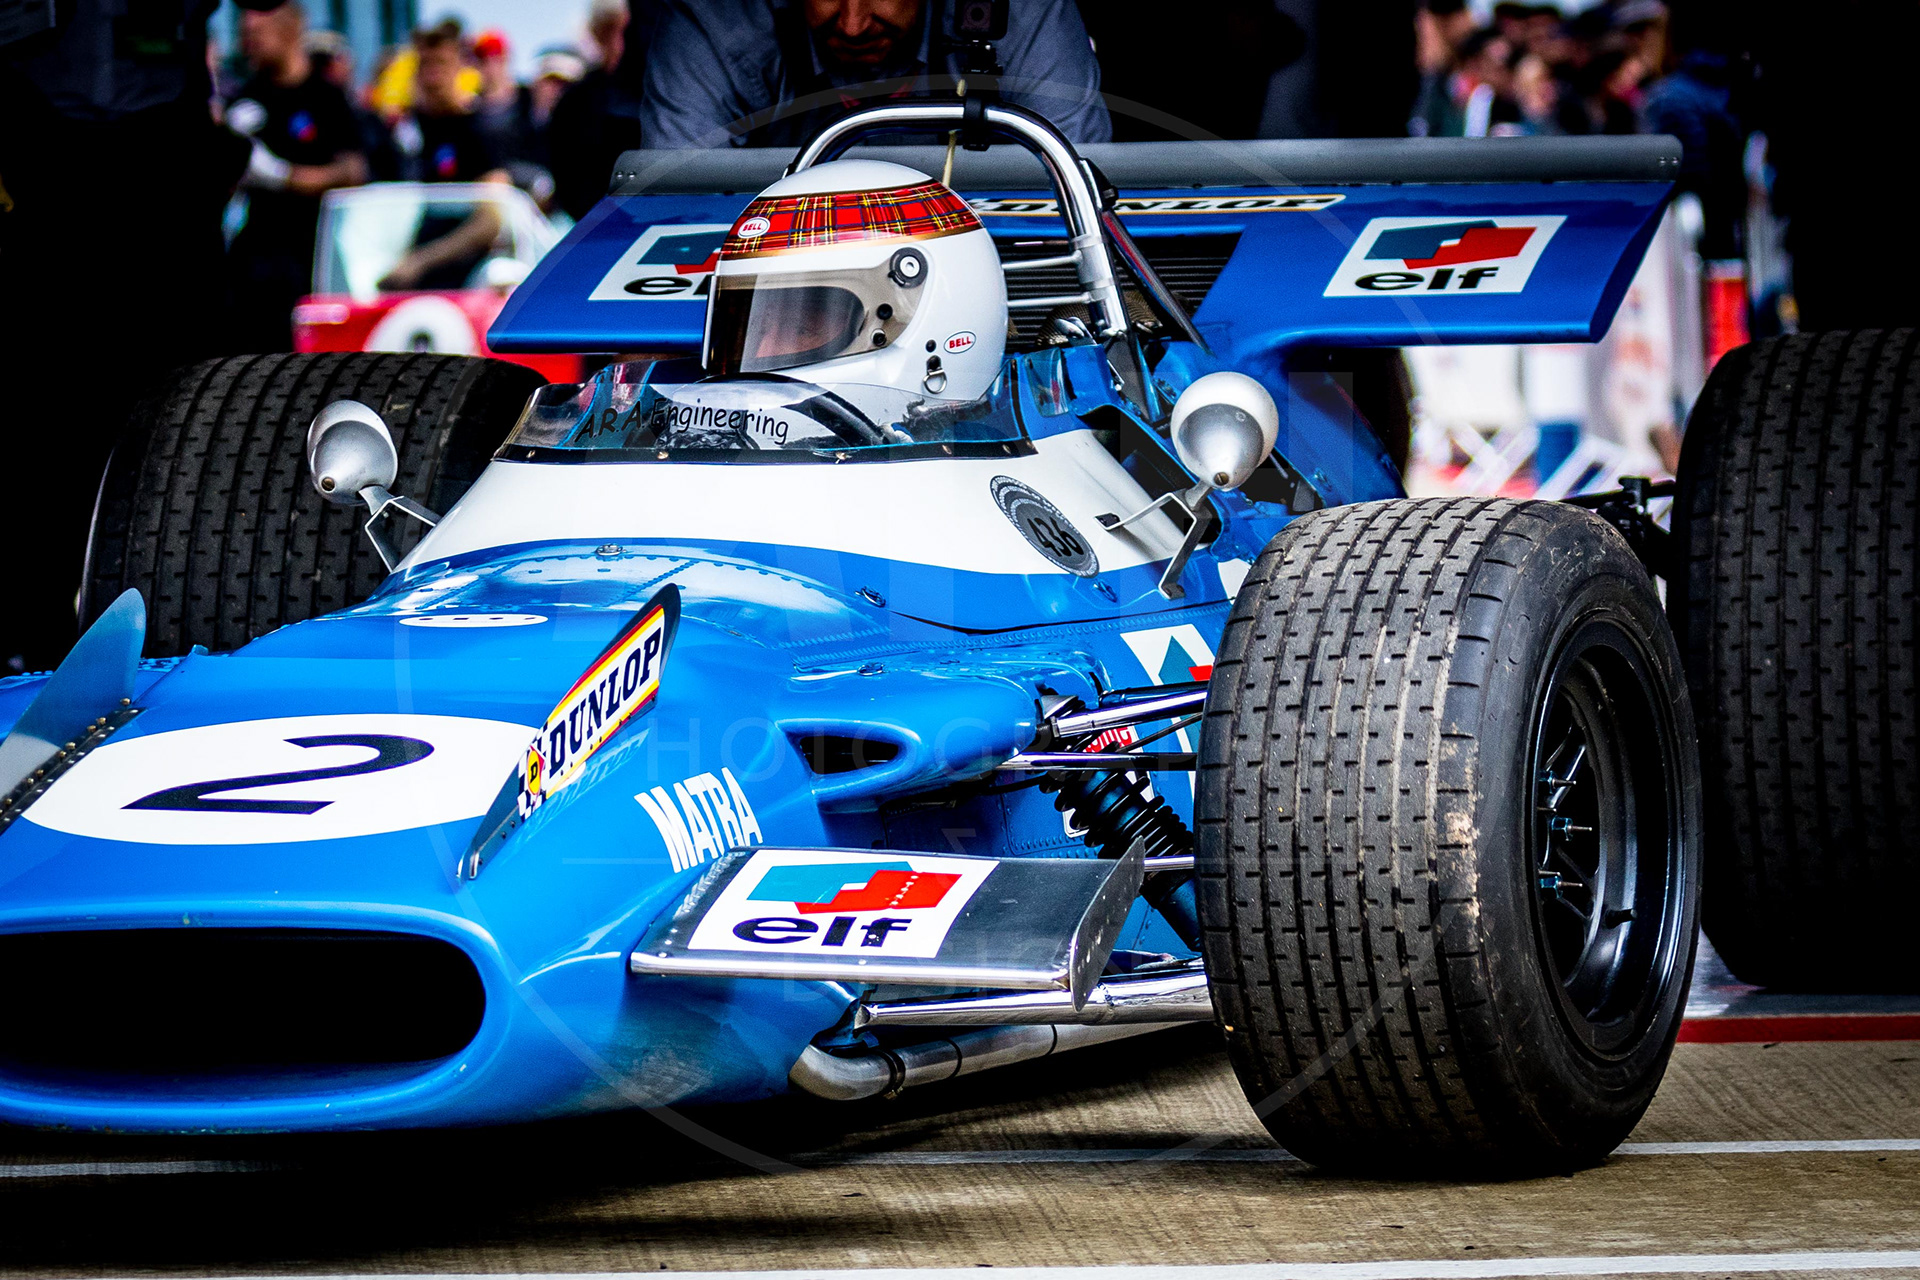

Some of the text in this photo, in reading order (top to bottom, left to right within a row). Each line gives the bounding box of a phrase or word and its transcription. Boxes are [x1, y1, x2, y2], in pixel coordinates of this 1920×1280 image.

[984, 197, 1338, 212] DNLOP
[743, 223, 762, 232] BELL
[623, 274, 715, 296] el
[1355, 266, 1499, 291] elf
[949, 336, 972, 349] BELL
[650, 397, 789, 445] Engineering
[1027, 517, 1085, 557] 436
[549, 626, 662, 779] DUNLOP
[119, 733, 435, 816] 2
[633, 766, 764, 874] MATRA
[732, 915, 913, 948] elf
